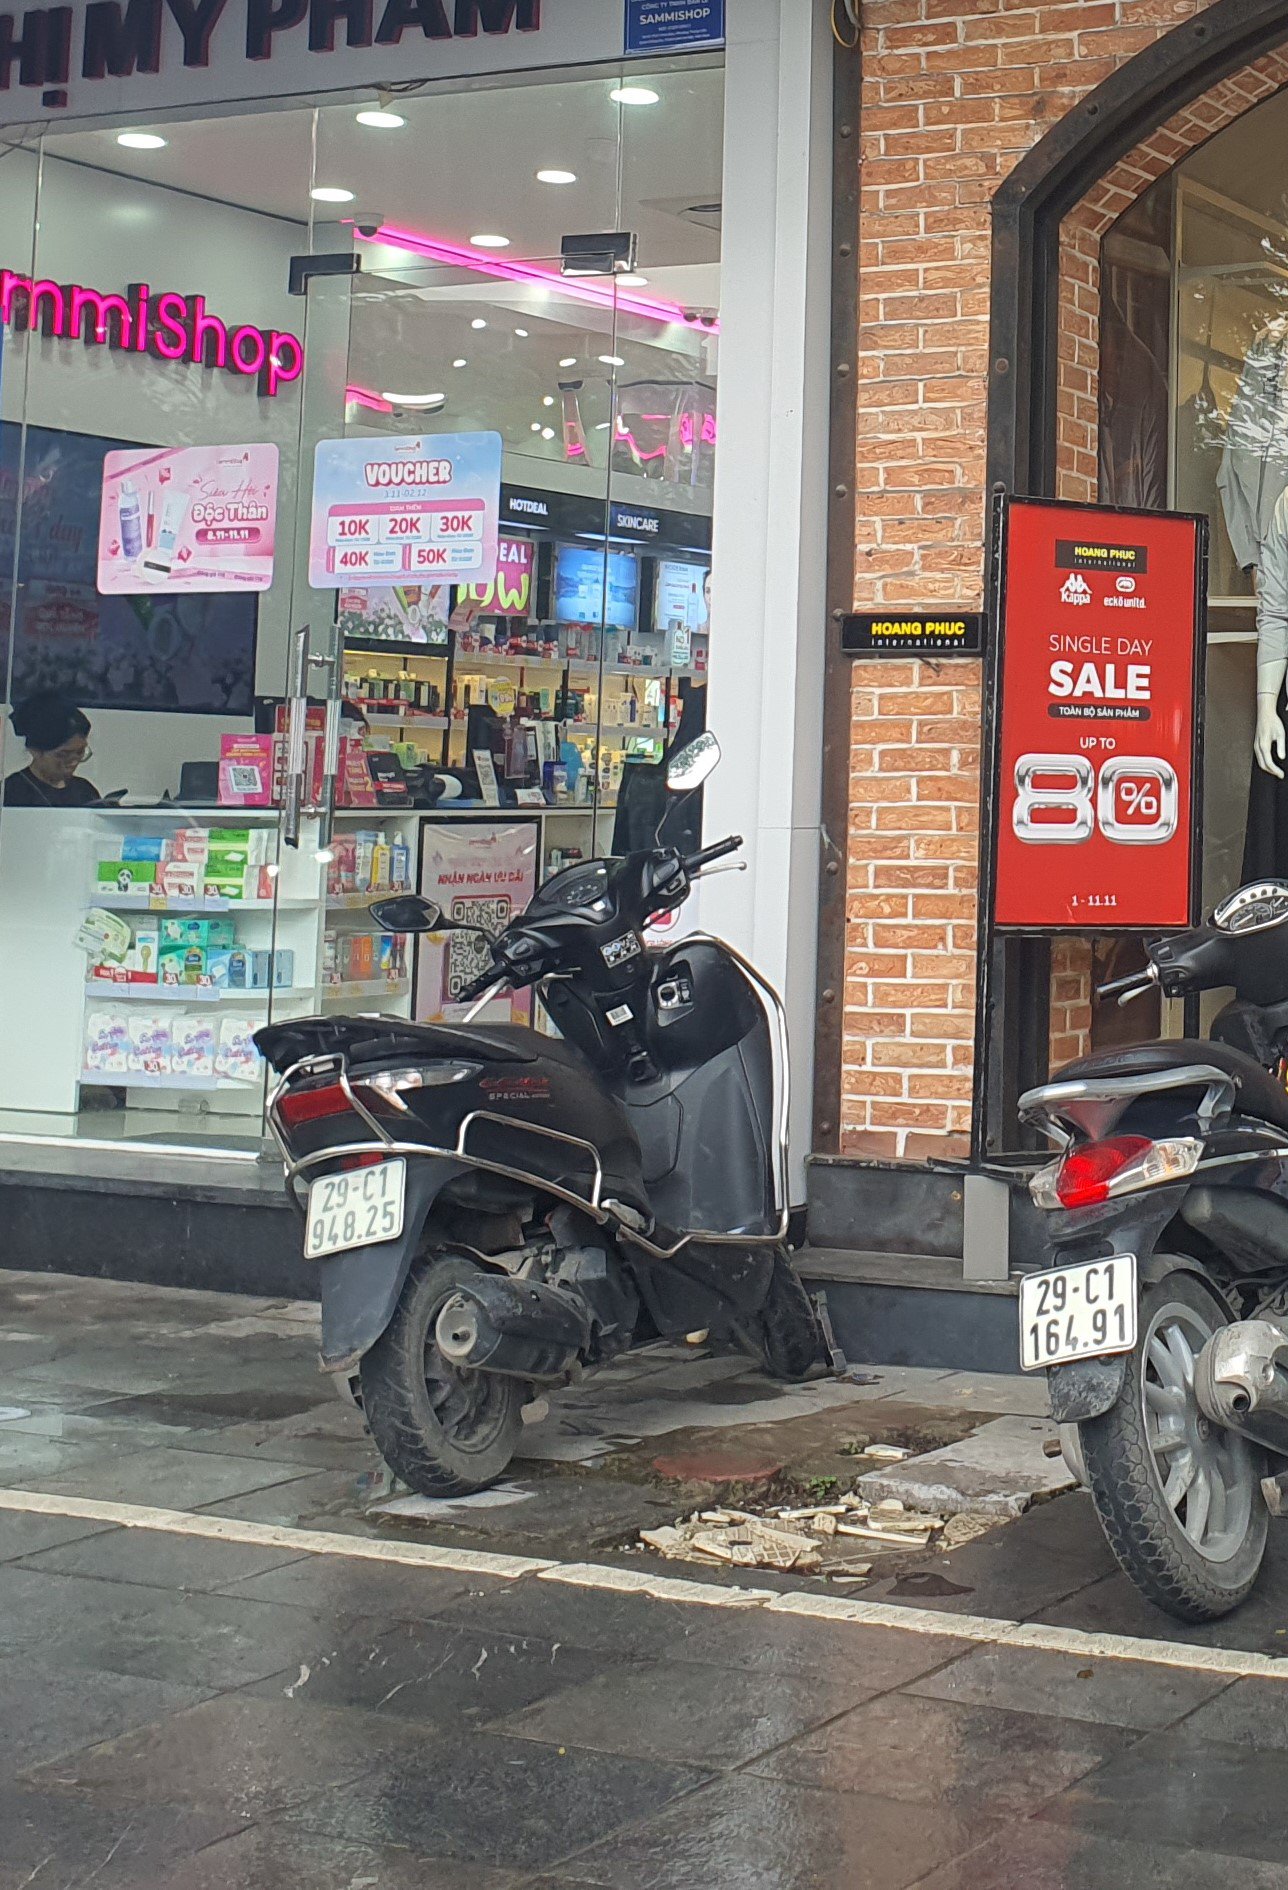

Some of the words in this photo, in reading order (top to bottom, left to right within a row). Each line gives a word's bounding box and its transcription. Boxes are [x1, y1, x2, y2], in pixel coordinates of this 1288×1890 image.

[639, 8, 711, 25] SAMMISHOP
[365, 459, 452, 487] VOUCHER
[192, 501, 225, 526] Độc
[226, 501, 268, 522] Thân
[509, 497, 549, 516] HOTDEAL
[338, 518, 370, 536] 10K
[388, 516, 421, 534] 20K
[439, 514, 473, 532] 30K
[617, 513, 660, 533] SKINCARE
[339, 551, 369, 567] 40K
[416, 548, 447, 564] 50K
[1074, 546, 1108, 558] HOANG
[1109, 547, 1136, 560] PHUC
[1074, 558, 1136, 568] international
[1060, 591, 1091, 606] Kappa
[871, 622, 922, 635] HOANG
[925, 621, 965, 635] PHUC
[871, 637, 965, 646] international
[1049, 634, 1111, 655] SINGLE
[1117, 638, 1152, 657] DAY
[1047, 659, 1151, 700] SALE
[1059, 705, 1082, 716] TOÀN
[1083, 706, 1095, 718] BỘ
[1097, 706, 1114, 717] SẢN
[1115, 706, 1139, 718] PHẨM
[1079, 737, 1097, 749] UP
[1099, 737, 1116, 750] TO
[1012, 753, 1179, 845] 80%
[437, 871, 465, 887] NHẬN
[1071, 894, 1079, 906] 1
[1087, 895, 1117, 906] 11.11
[489, 1092, 531, 1100] SPECIAL
[322, 1166, 388, 1213] 29-C1
[312, 1200, 395, 1250] 948.25
[1036, 1263, 1115, 1317] 29-C1
[1030, 1303, 1126, 1361] 164.91
